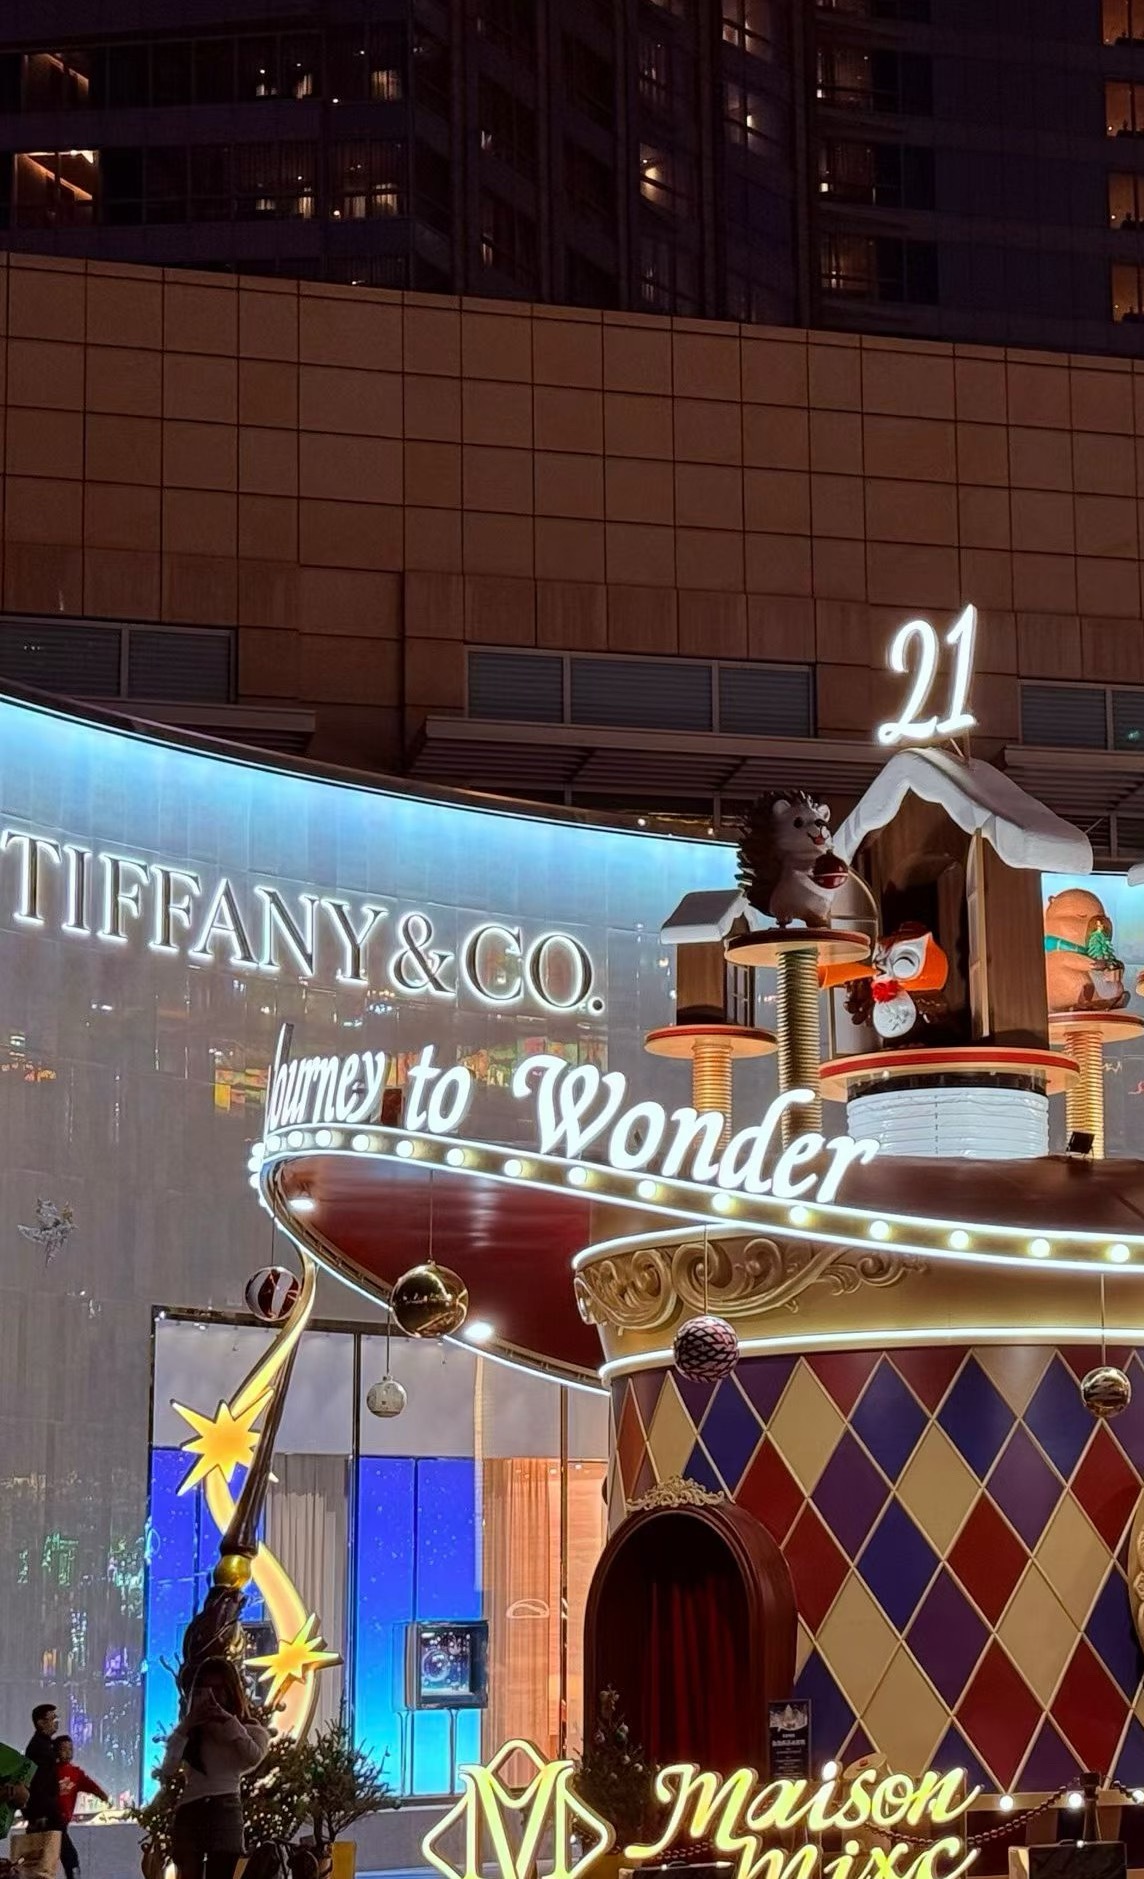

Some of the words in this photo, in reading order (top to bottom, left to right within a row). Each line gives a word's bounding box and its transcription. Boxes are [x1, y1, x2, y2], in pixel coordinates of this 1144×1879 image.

[878, 604, 977, 743] 21
[404, 1044, 475, 1133] to
[512, 1054, 880, 1204] Wonder
[624, 1760, 984, 1859] Maison
